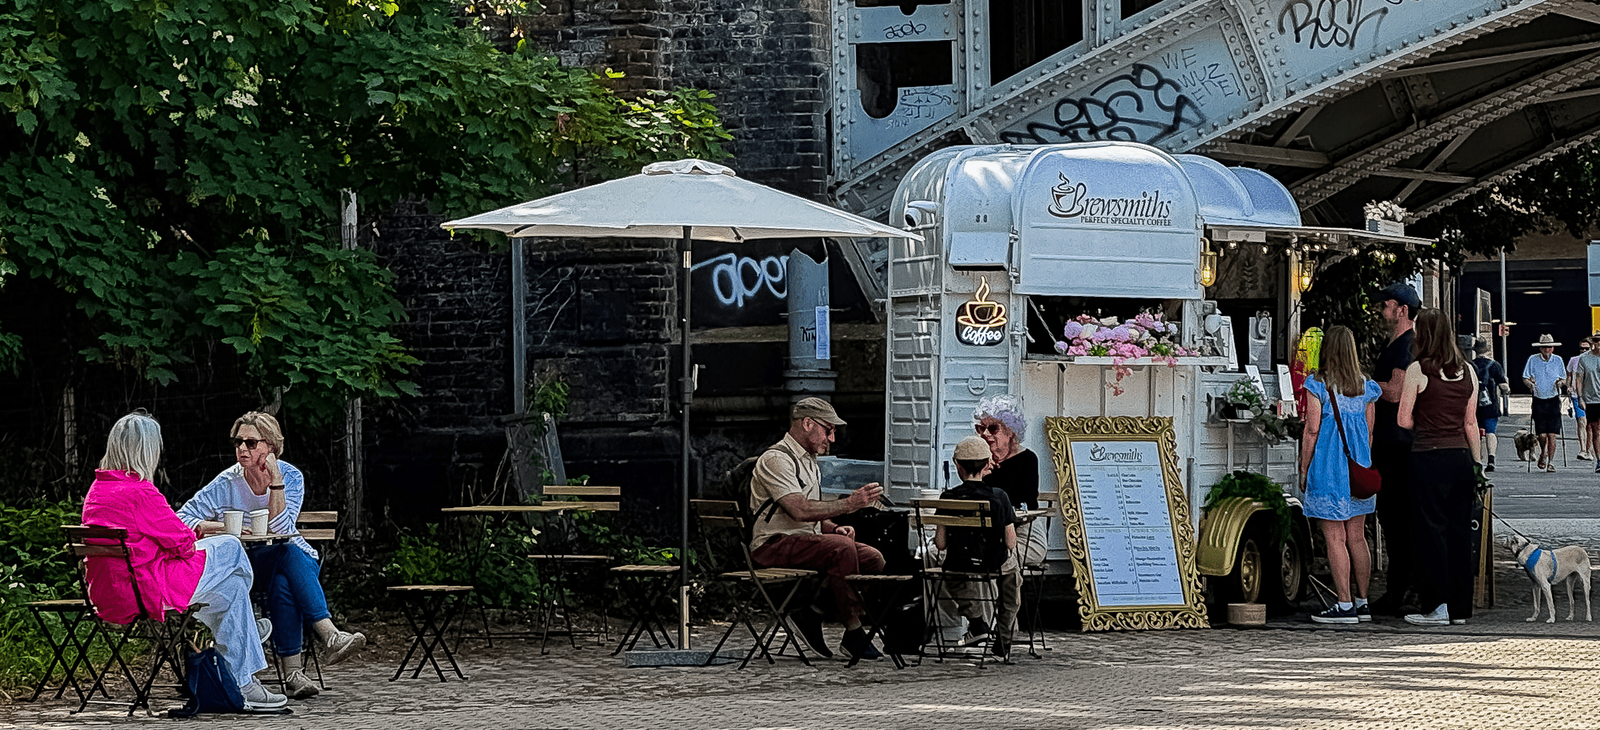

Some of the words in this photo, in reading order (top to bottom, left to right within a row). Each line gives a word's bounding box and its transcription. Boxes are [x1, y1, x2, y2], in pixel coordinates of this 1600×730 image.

[1161, 47, 1197, 69] WE
[1178, 62, 1226, 88] WUZ
[1047, 182, 1172, 219] Brewsmiths
[1080, 216, 1110, 224] PERFECT
[1110, 217, 1146, 226] SPECIALTY
[1146, 218, 1172, 227] COFFEE
[962, 326, 1002, 345] Coffee
